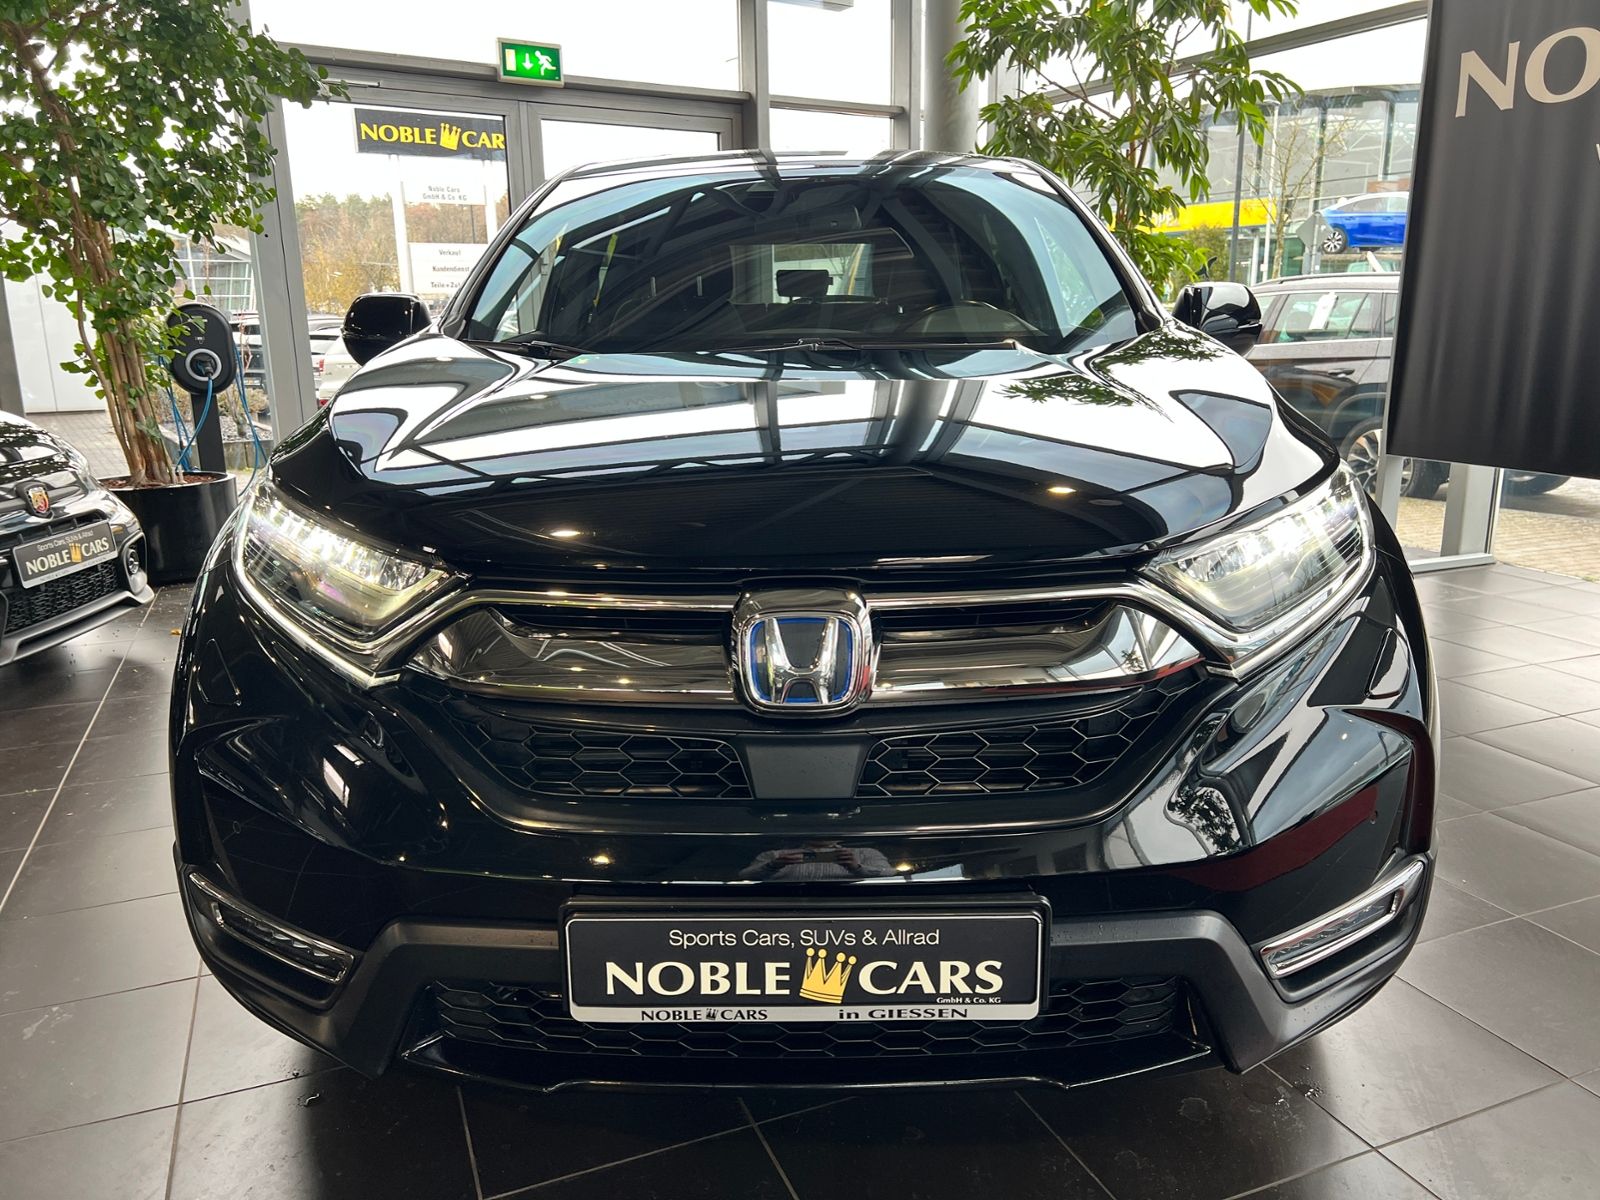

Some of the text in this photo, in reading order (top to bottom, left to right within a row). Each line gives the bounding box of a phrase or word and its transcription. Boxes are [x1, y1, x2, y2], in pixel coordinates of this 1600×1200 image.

[1455, 26, 1600, 118] NO
[360, 122, 438, 145] NOBLE
[428, 185, 445, 193] Noble
[25, 549, 71, 575] NOBLE
[81, 537, 110, 557] CARS
[668, 929, 940, 949] Sports Cars, SUVs & Allrad
[605, 960, 1004, 996] NOBLE CARS
[640, 1008, 968, 1021] NOBLE CARS in GIESSEN
